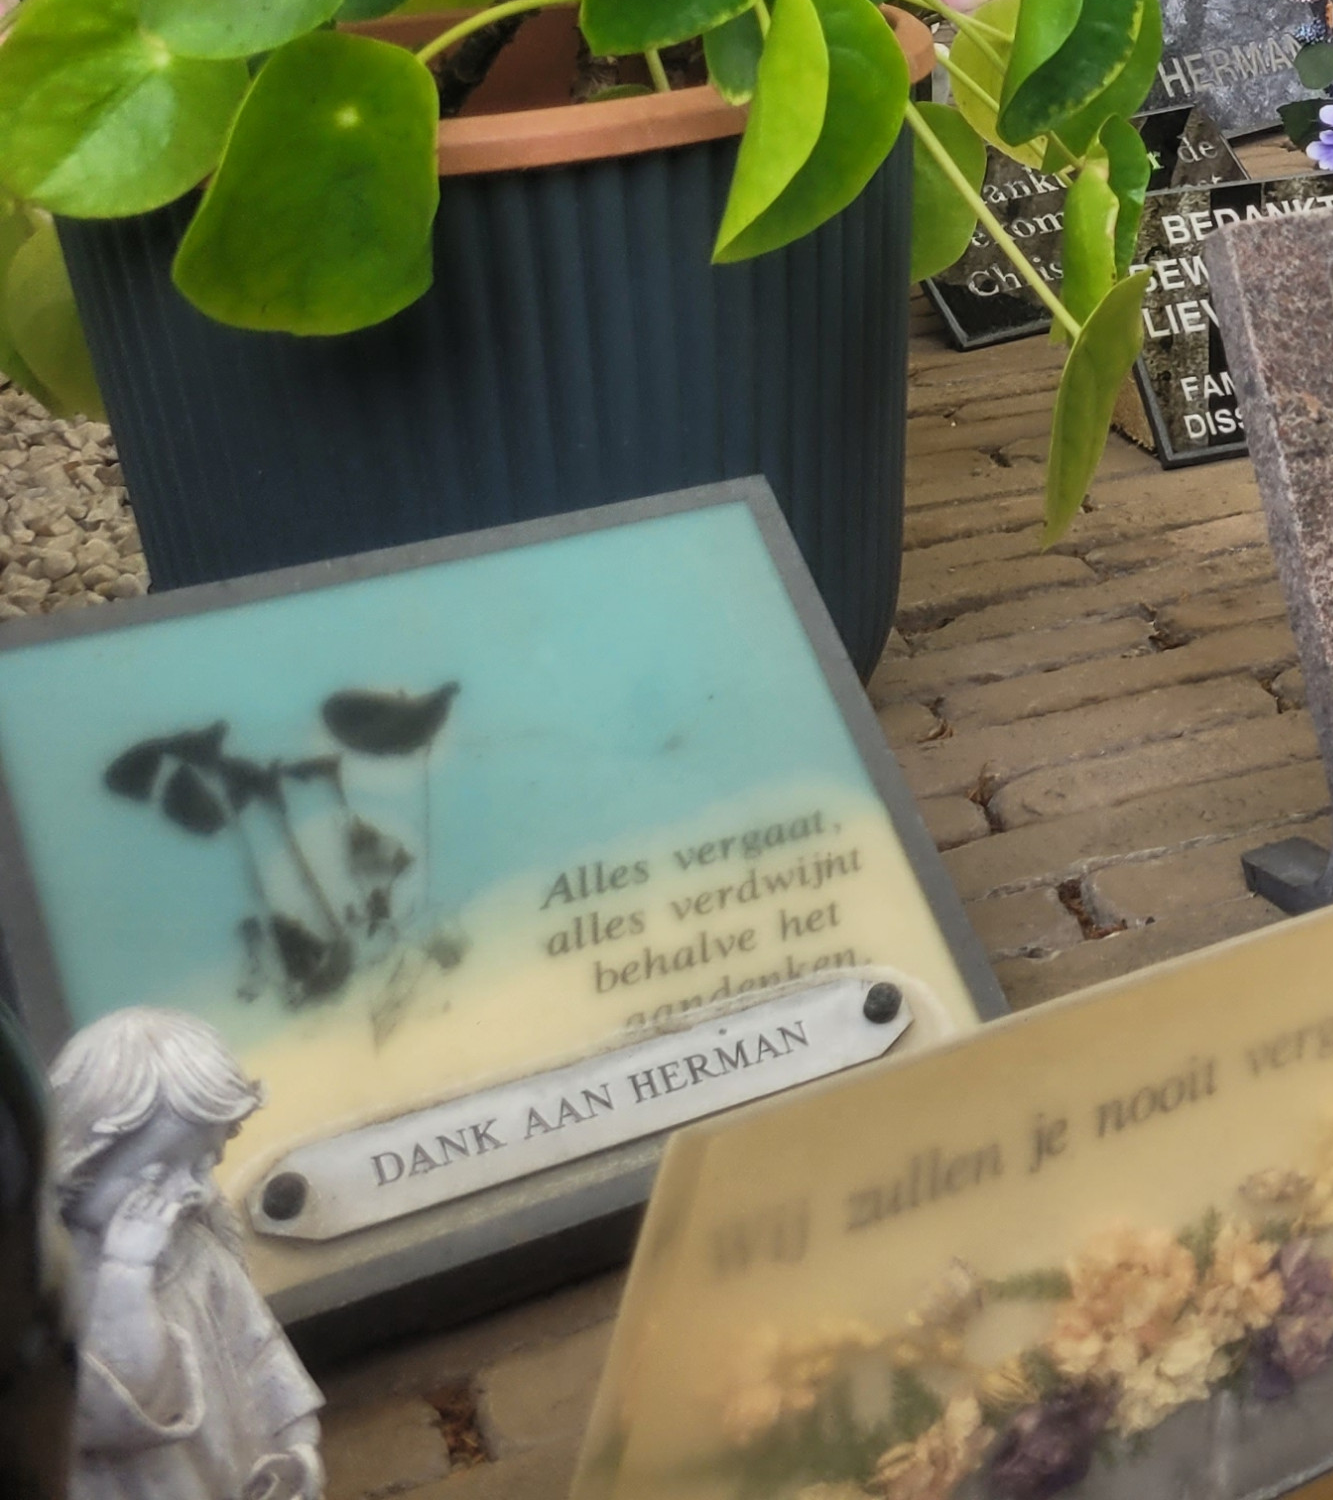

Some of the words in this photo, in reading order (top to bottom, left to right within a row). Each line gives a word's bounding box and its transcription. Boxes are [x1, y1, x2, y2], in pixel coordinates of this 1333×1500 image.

[539, 859, 650, 912] Alles
[673, 808, 842, 871] vergaat,
[546, 911, 645, 958] alles
[671, 846, 863, 920] verdwijnt
[595, 927, 756, 997] behalve
[780, 900, 841, 943] het
[371, 1118, 507, 1187] DANK
[523, 1082, 615, 1141] AAN
[628, 1020, 810, 1106] HERMAN
[846, 1136, 1008, 1232] zullen
[1029, 1111, 1069, 1174] je
[1096, 1055, 1219, 1139] nooit
